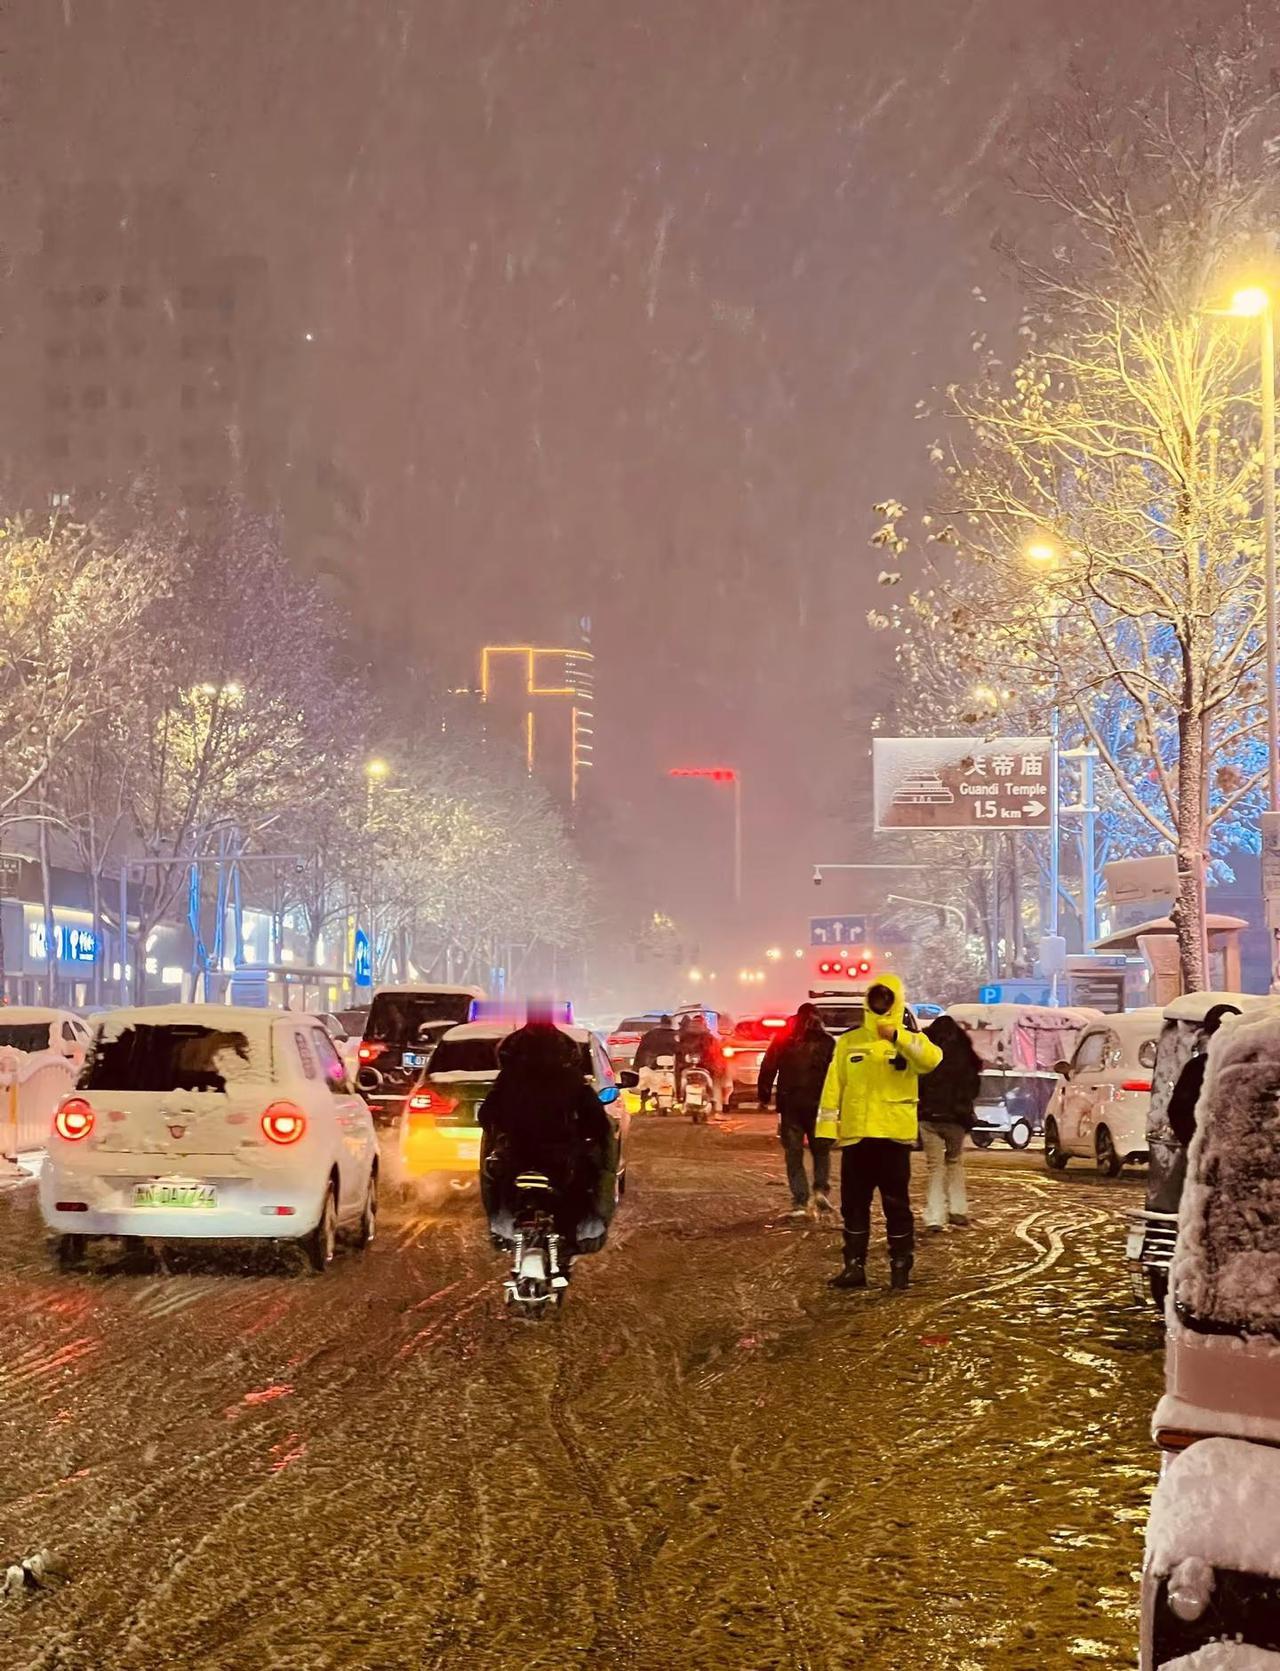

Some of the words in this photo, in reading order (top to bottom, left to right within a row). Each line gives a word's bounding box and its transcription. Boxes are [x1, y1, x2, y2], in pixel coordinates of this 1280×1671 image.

[959, 782, 999, 796] Guandi
[1004, 783, 1047, 798] Temple
[974, 800, 998, 818] 1.5
[1000, 808, 1022, 818] km
[984, 988, 997, 1004] P
